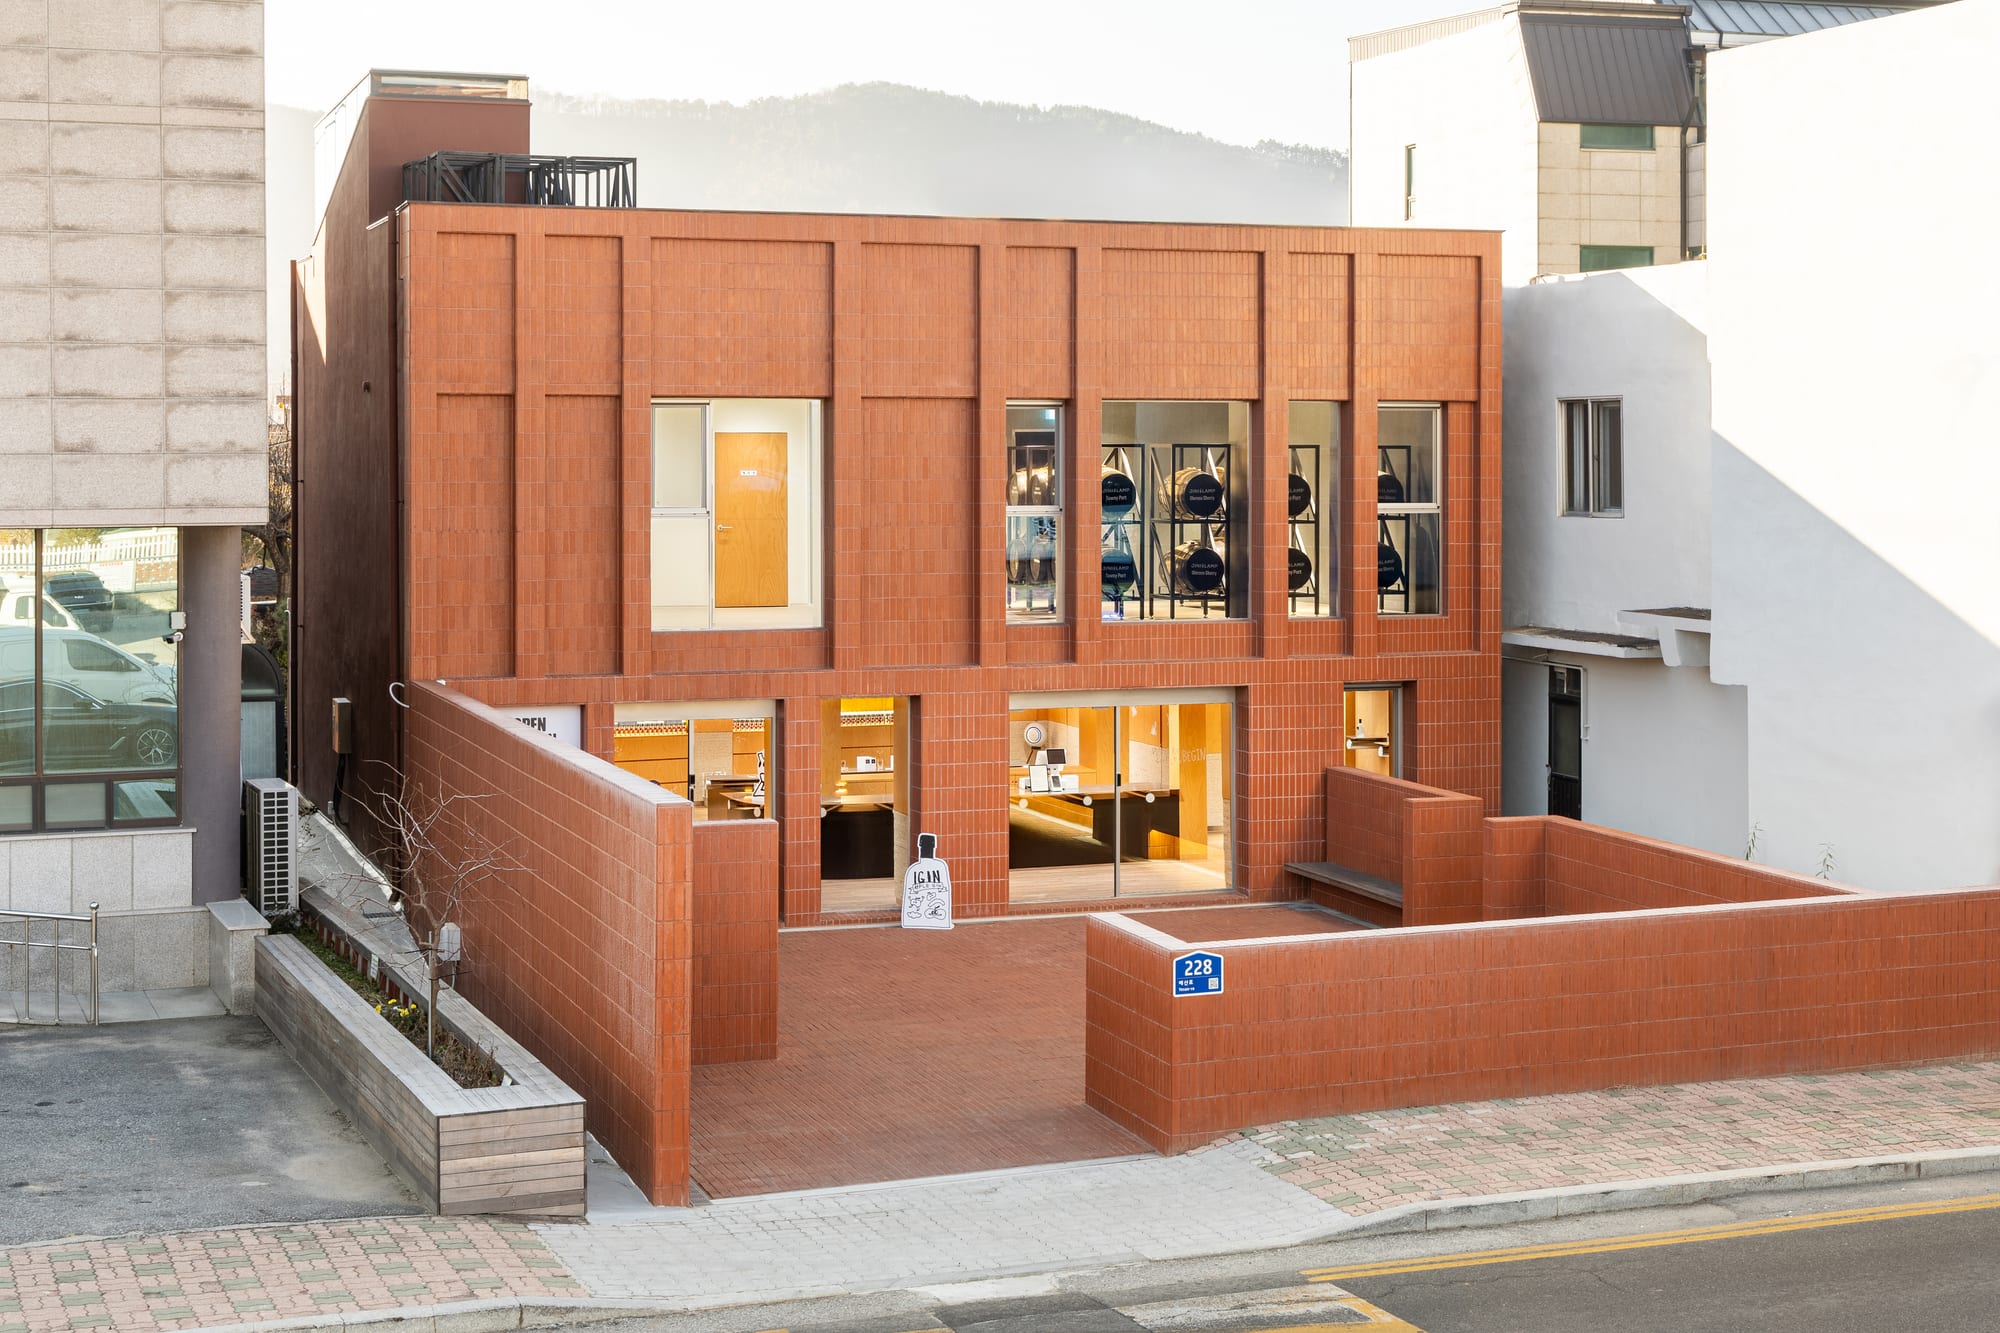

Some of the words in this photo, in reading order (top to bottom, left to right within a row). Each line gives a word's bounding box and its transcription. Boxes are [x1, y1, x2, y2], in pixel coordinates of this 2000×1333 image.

[515, 717, 546, 731] PEN
[1182, 748, 1206, 762] BEGIN
[913, 870, 941, 885] IGIN
[1184, 958, 1212, 976] 228
